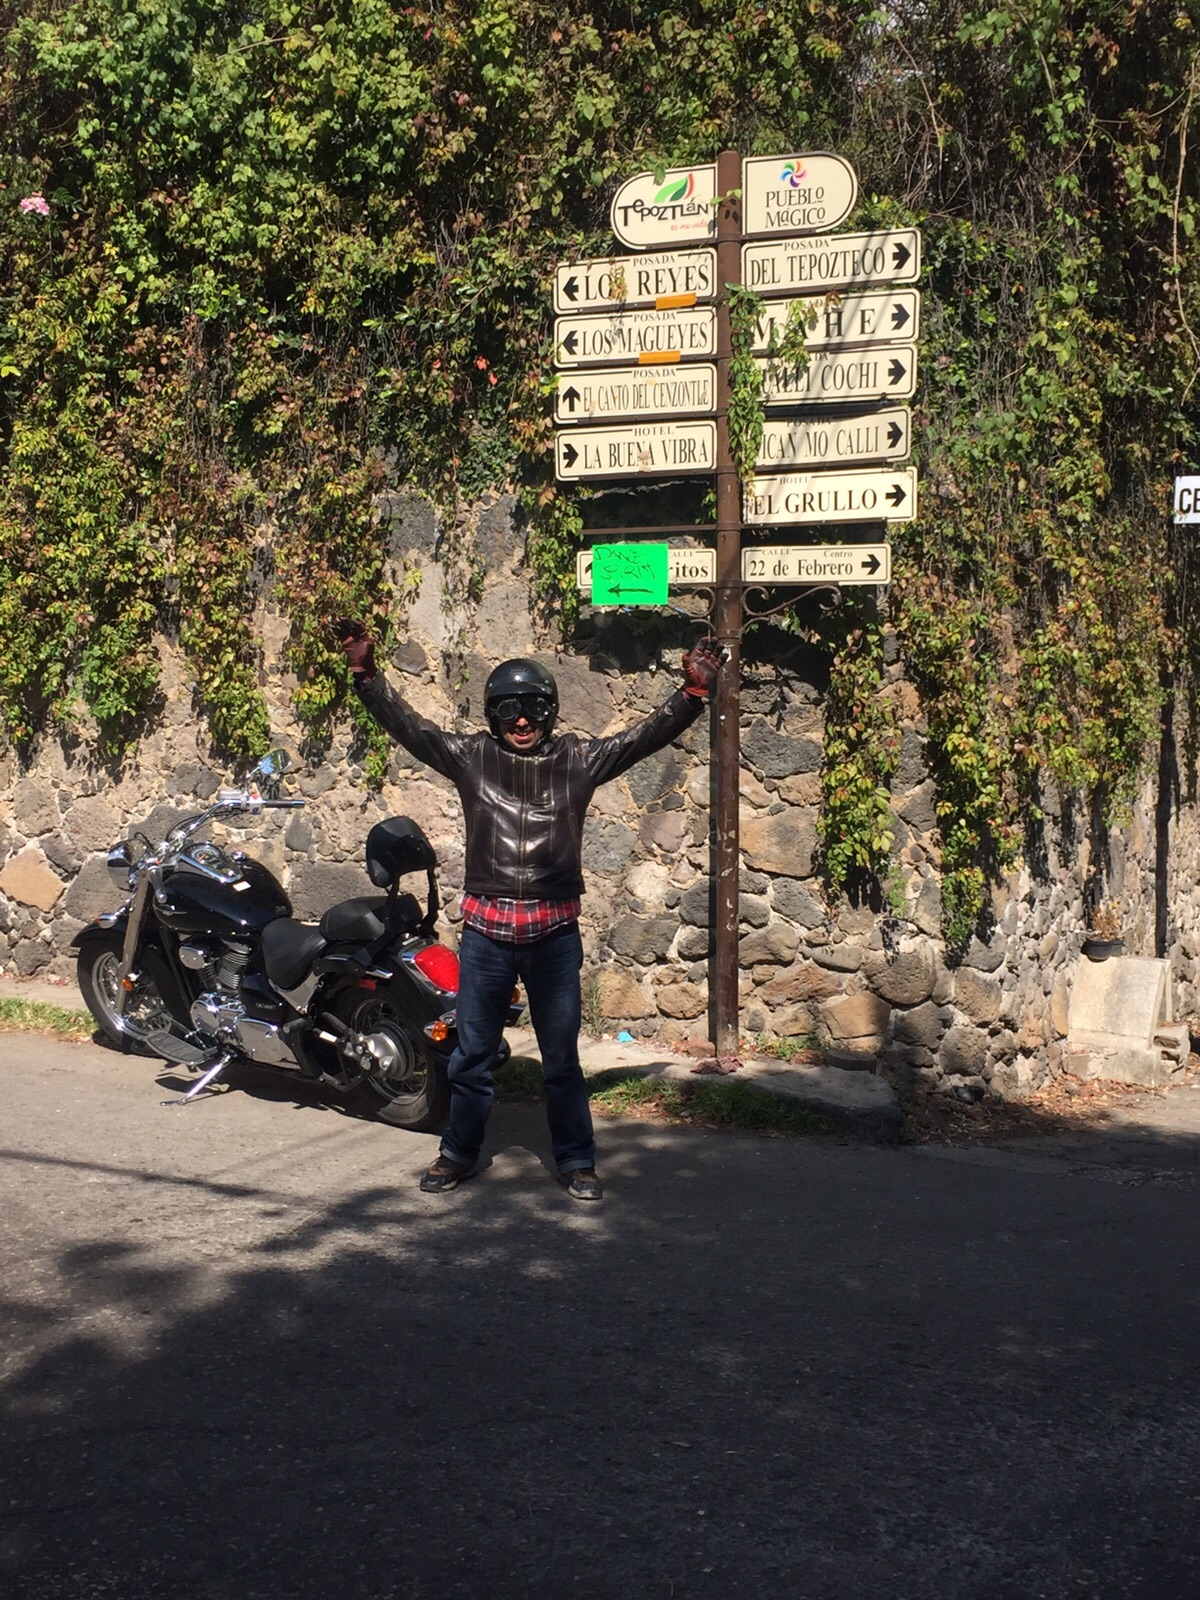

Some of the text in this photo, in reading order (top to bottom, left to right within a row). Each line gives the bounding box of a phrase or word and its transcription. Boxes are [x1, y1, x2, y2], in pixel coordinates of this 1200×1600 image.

[784, 239, 830, 251] POSADA
[633, 255, 676, 267] POSADA
[750, 246, 886, 286] DEL TEPOZTECO
[584, 264, 710, 301] LO REYES
[633, 312, 676, 323] POSADA
[582, 321, 708, 356] LOS MAGUEYES
[633, 368, 676, 379] POSADA
[821, 361, 879, 391] COCHI
[598, 384, 630, 412] CANTO
[632, 382, 650, 409] DEL
[653, 379, 709, 408] CENZONTLE
[787, 417, 832, 427] POSADA
[634, 426, 675, 437] HOTEL
[757, 426, 880, 460] ICAN MO CALLI
[584, 437, 709, 469] LA BUENA VIBRA
[779, 476, 809, 485] HOTEL
[754, 488, 878, 516] EL GRULLO
[823, 550, 853, 558] Centro
[750, 559, 854, 577] 22 de Febrero
